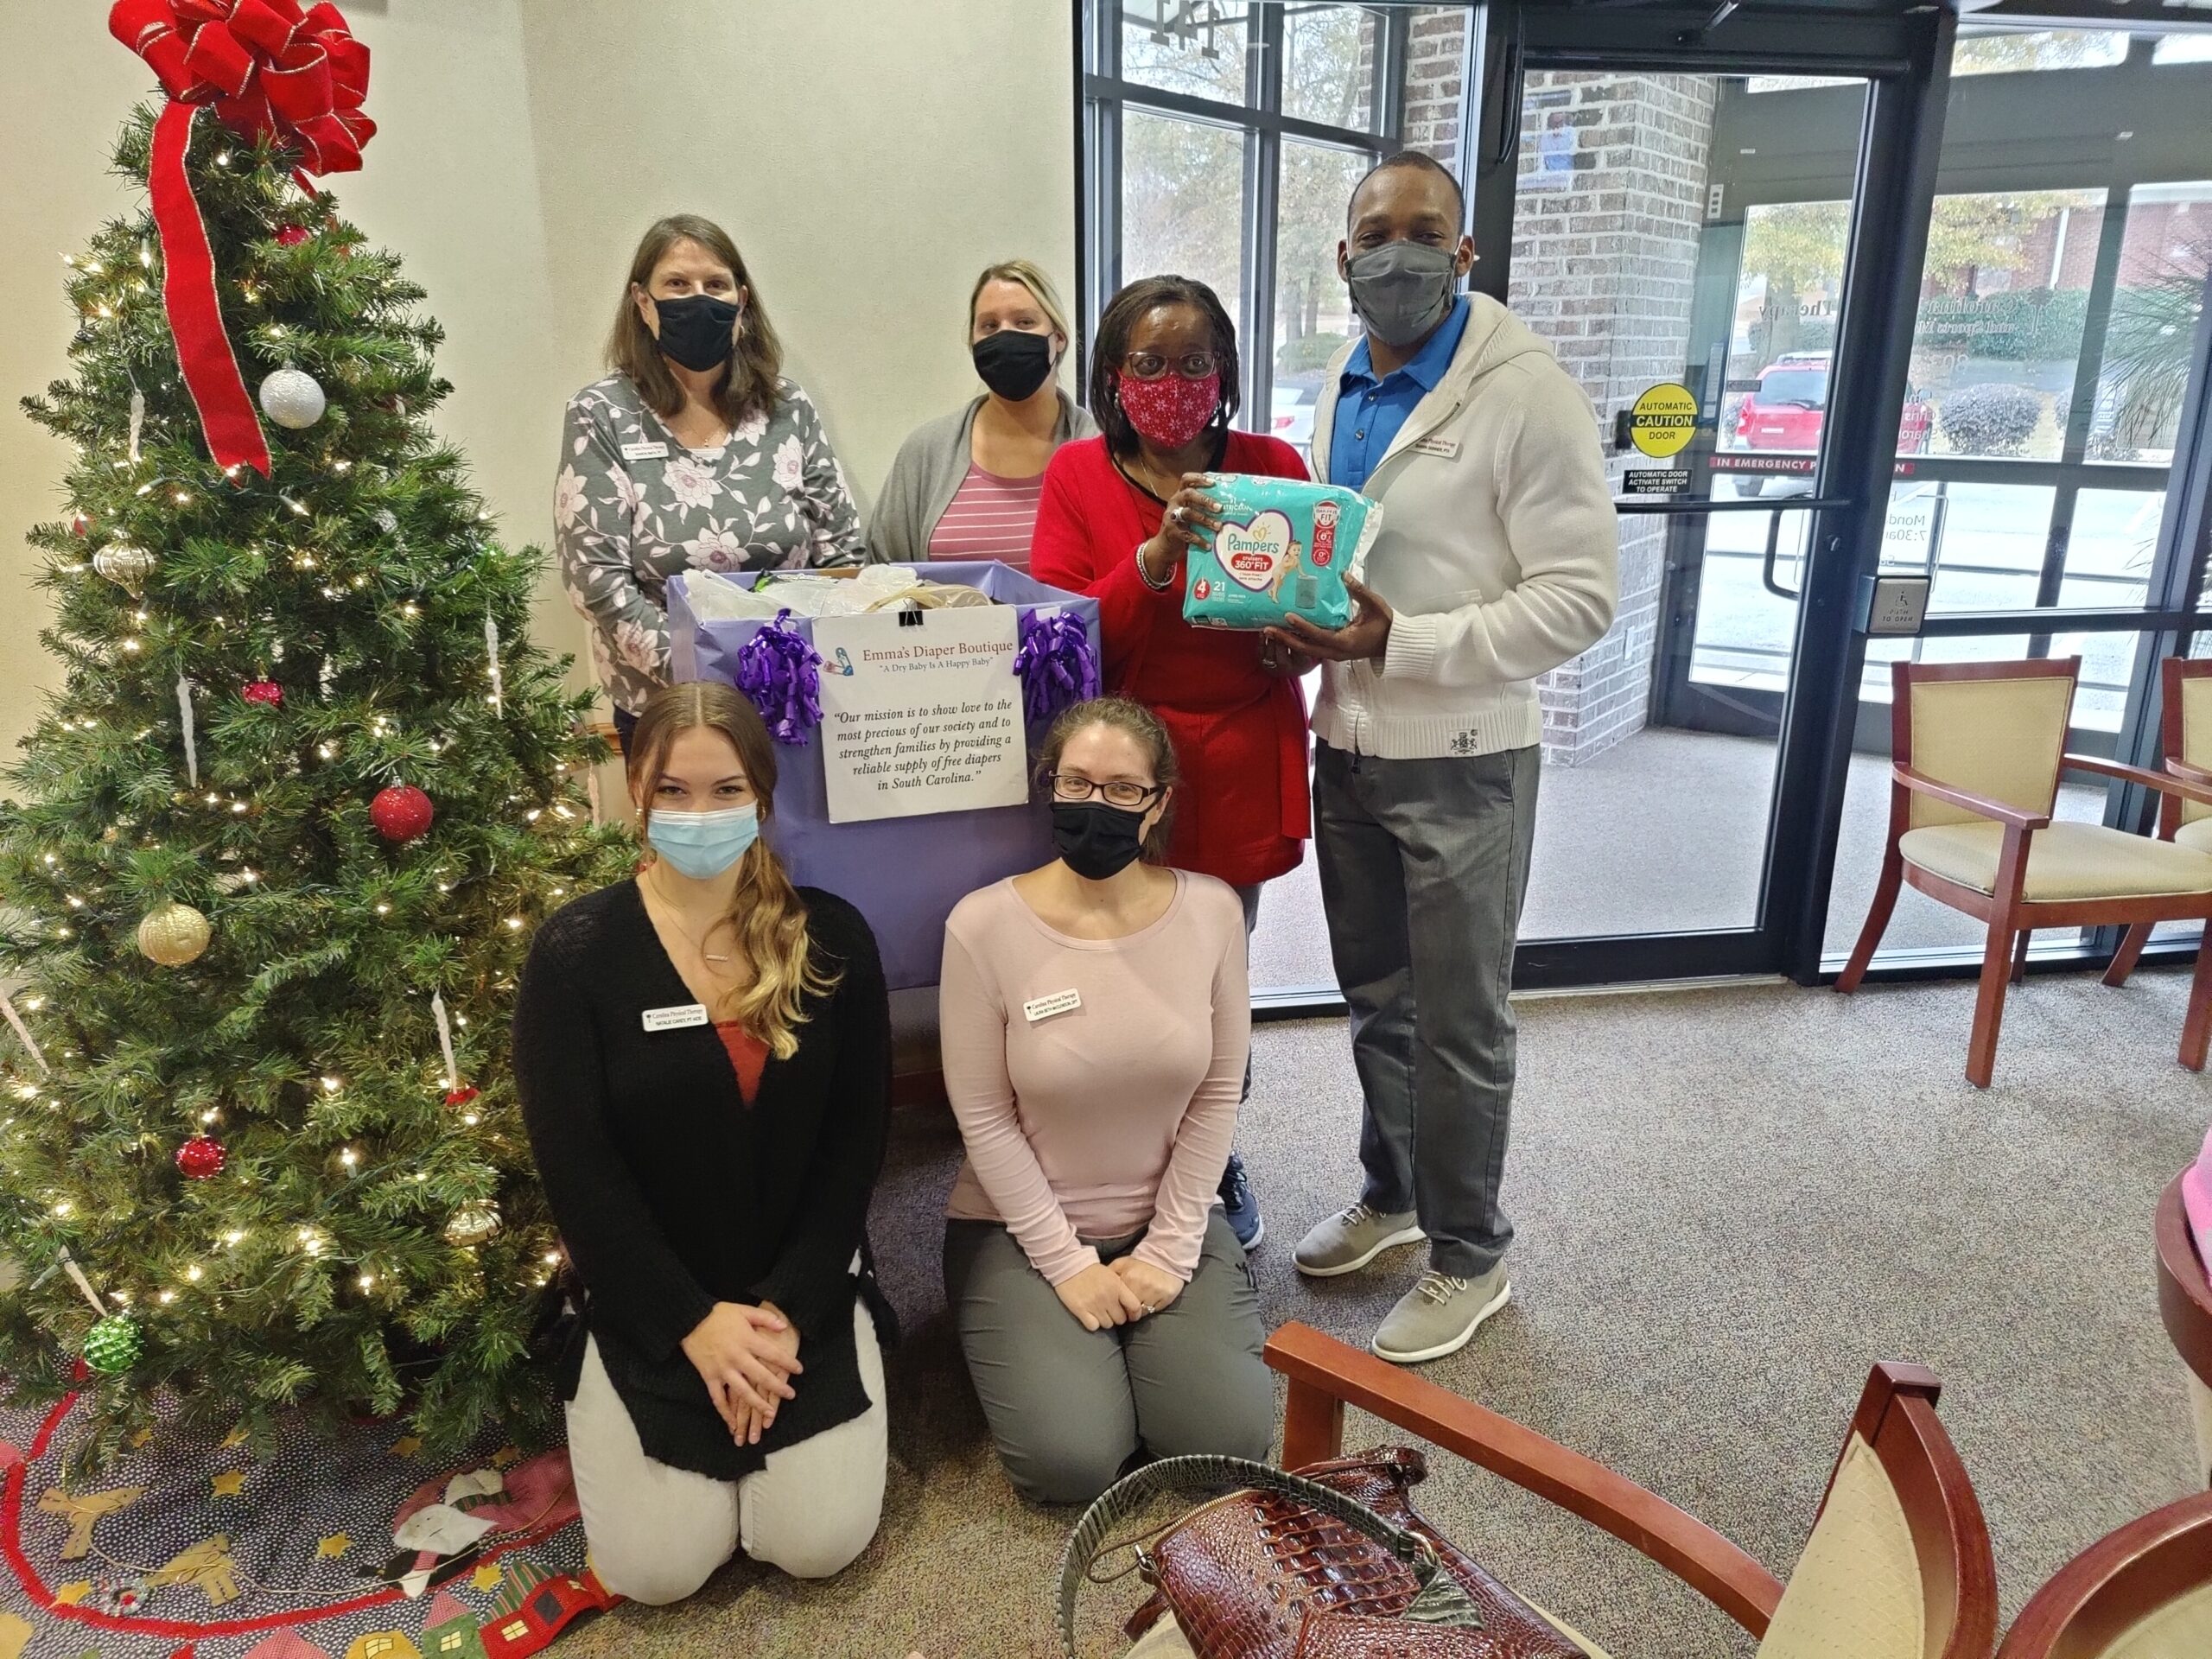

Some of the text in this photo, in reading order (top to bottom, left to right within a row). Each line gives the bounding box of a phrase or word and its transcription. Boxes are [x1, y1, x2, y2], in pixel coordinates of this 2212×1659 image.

[1637, 416, 1692, 426] CAUTION
[1717, 458, 1729, 467] IN
[1734, 459, 1805, 469] EMERGENCY
[1228, 533, 1279, 554] Pampers
[1197, 581, 1225, 594] 4 21
[863, 641, 1013, 662] Emma's Diaper Boutique
[892, 664, 907, 673] Dry
[908, 661, 928, 671] Baby
[929, 661, 936, 670] Is
[938, 660, 947, 669] A
[947, 658, 970, 670] Happy
[834, 699, 1012, 723] "Our mission is to show love to the
[836, 716, 1011, 742] most precious of our society and to
[838, 735, 1012, 760] strengthen families by providing a
[853, 753, 1001, 775] reliable supply of free diapers
[877, 770, 982, 791] in South Carolina."
